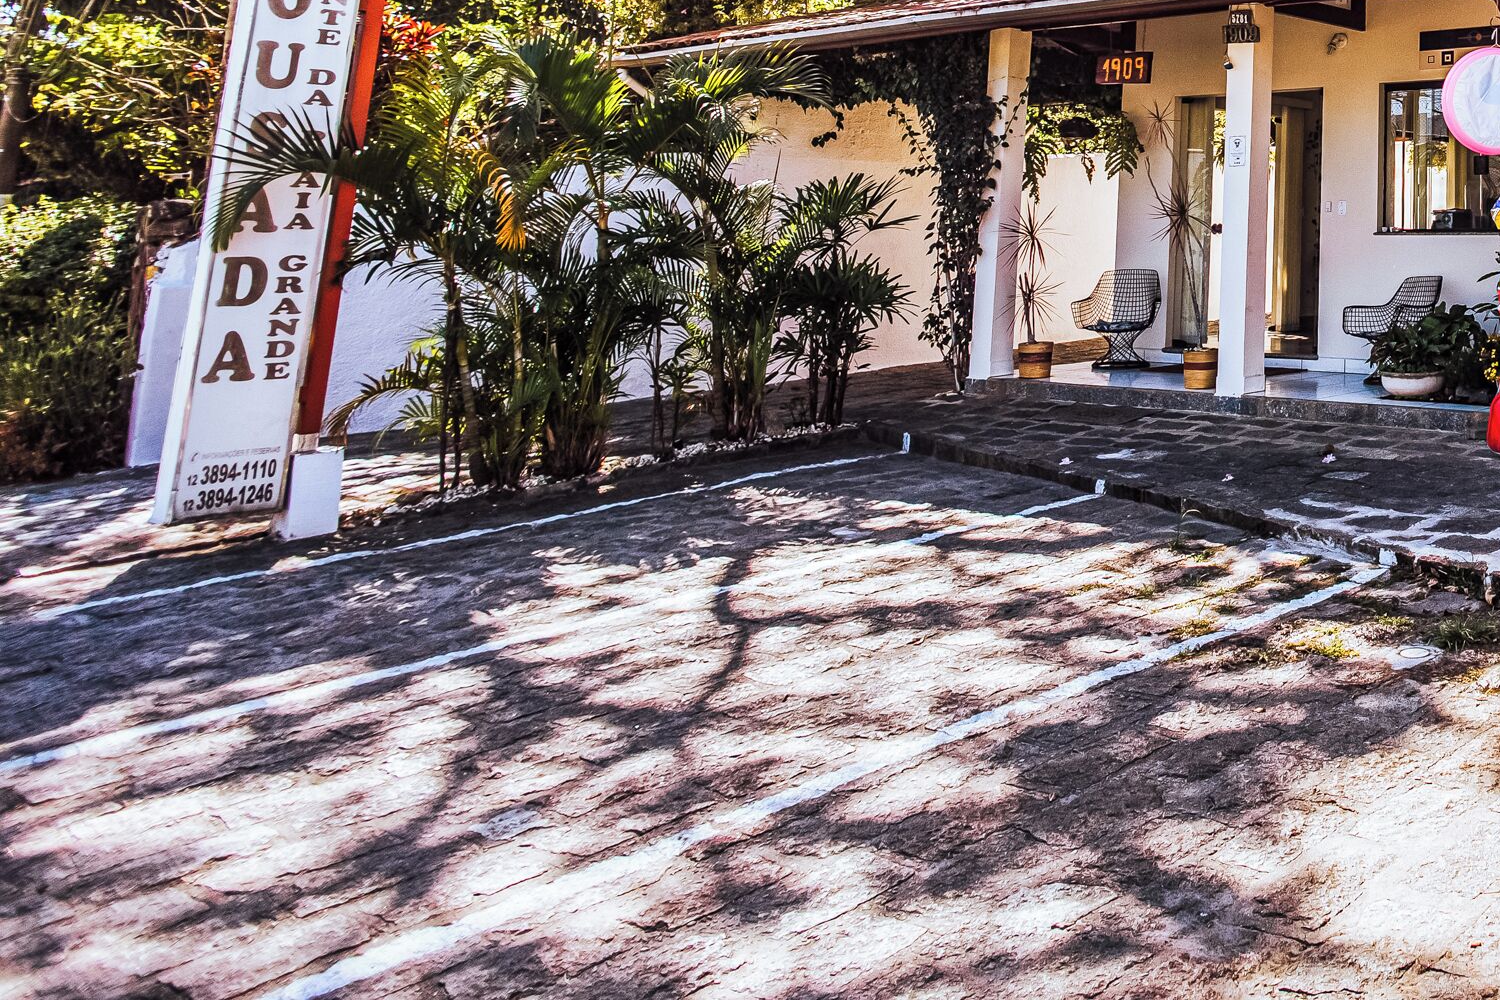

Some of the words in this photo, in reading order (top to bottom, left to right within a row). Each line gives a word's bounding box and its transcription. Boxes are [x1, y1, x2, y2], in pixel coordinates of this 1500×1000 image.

[1223, 25, 1258, 43] 1909
[1102, 56, 1144, 82] 1909
[303, 68, 336, 107] DA
[263, 255, 307, 380] GRANDE
[187, 474, 198, 486] 12
[200, 458, 277, 485] 3894-1110
[183, 499, 195, 511] 12
[196, 482, 274, 511] 3894-1246
